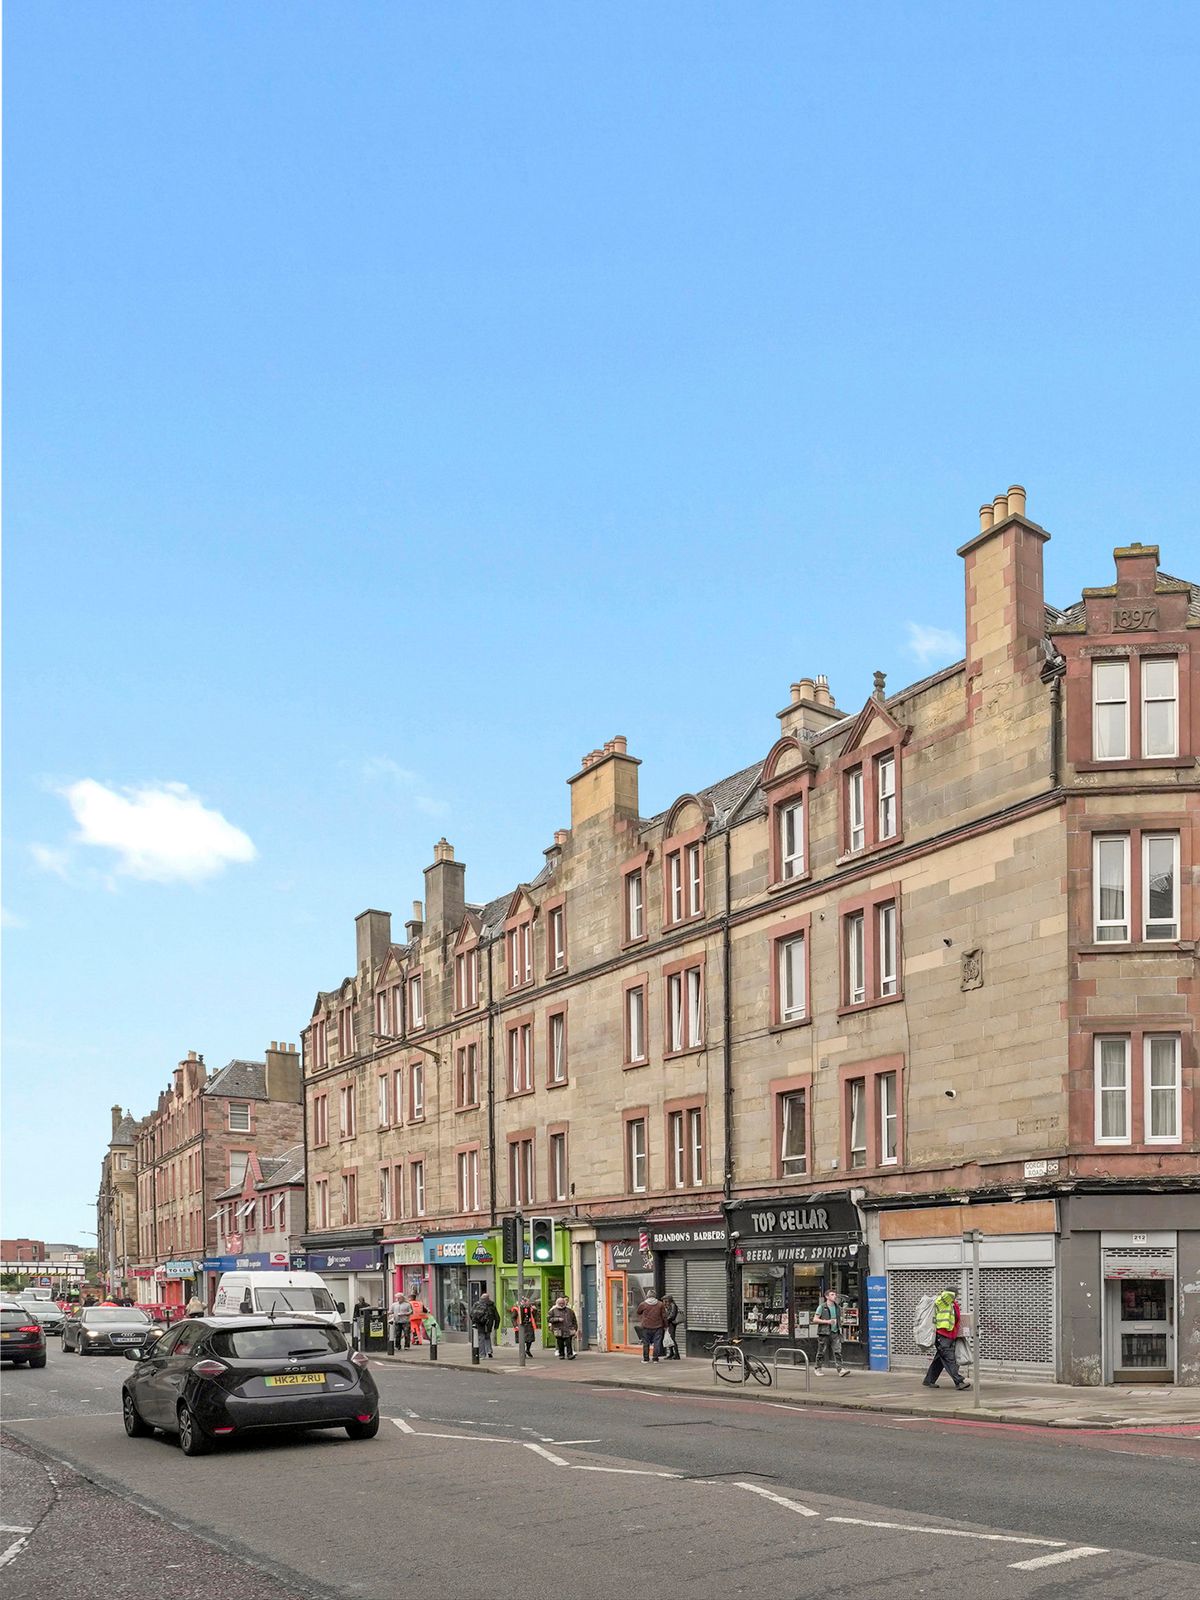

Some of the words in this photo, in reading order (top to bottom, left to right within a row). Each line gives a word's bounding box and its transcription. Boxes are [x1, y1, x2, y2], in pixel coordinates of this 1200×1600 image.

[1113, 609, 1156, 630] 1897
[751, 1211, 776, 1233] TOP
[780, 1208, 829, 1231] CELLAR
[653, 1232, 691, 1243] BRANDON'S
[693, 1230, 726, 1241] BARBERS
[443, 1242, 466, 1257] GREGG
[746, 1249, 774, 1262] BEERS,
[777, 1248, 808, 1261] WINES,
[811, 1246, 848, 1259] SPIRITS
[274, 1375, 299, 1385] HK21
[300, 1374, 321, 1383] ZRU
